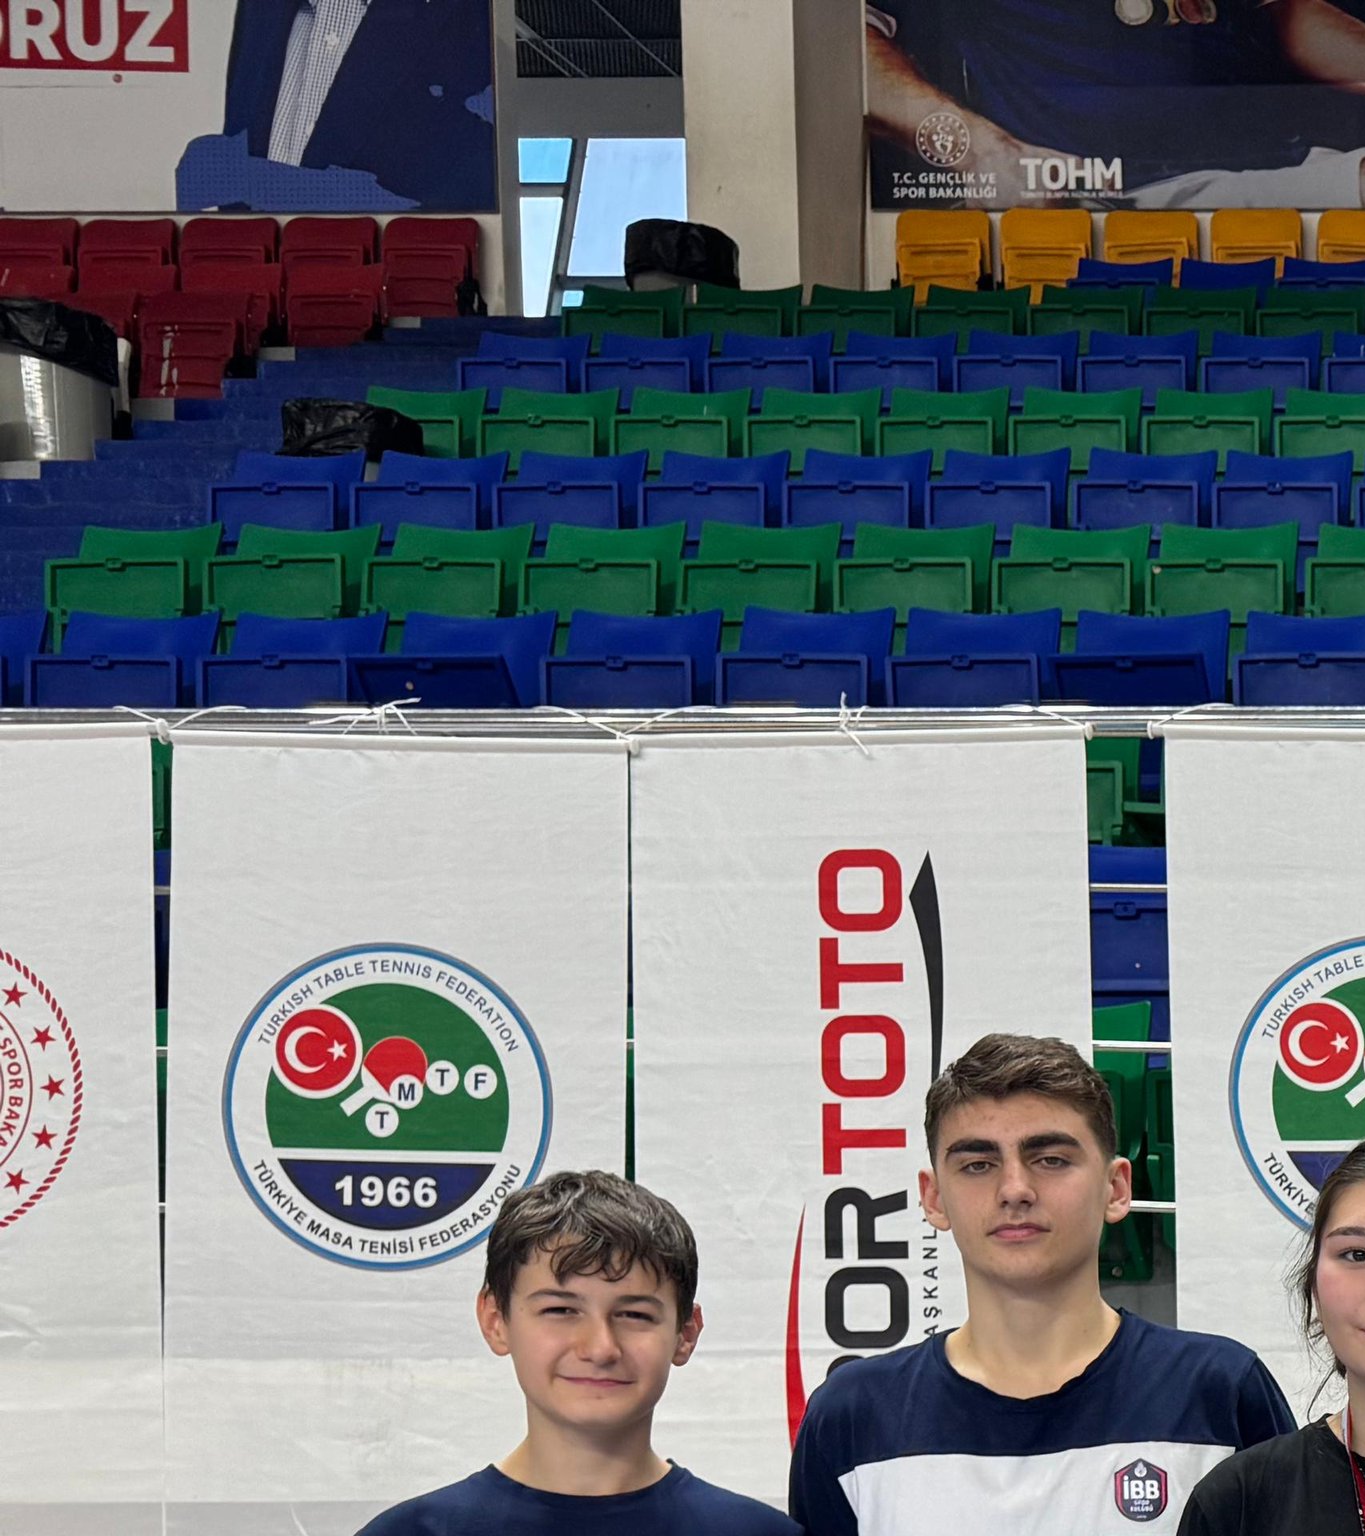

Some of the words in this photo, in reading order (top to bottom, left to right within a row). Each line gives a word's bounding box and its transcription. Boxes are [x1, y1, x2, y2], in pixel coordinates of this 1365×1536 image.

[0, 0, 175, 62] RUZ
[893, 172, 915, 185] T.C.
[919, 170, 976, 187] GENÇLİK
[980, 172, 996, 185] VE
[893, 187, 926, 199] SPOR
[929, 185, 996, 199] BAKANLIĞI
[1019, 157, 1122, 190] TOHM
[258, 983, 314, 1046] TURKISH
[313, 961, 366, 990] TABLE
[369, 959, 433, 978] TENNIS
[435, 971, 519, 1053] FEDERATION
[1261, 978, 1315, 1040] TURKISH
[1314, 954, 1365, 984] TABLE
[253, 1159, 306, 1226] TÜRKİYE
[306, 1219, 353, 1250] MASA
[359, 1236, 414, 1255] TENİSİ
[418, 1164, 521, 1252] FEDERASYONU
[334, 1175, 438, 1208] 1966
